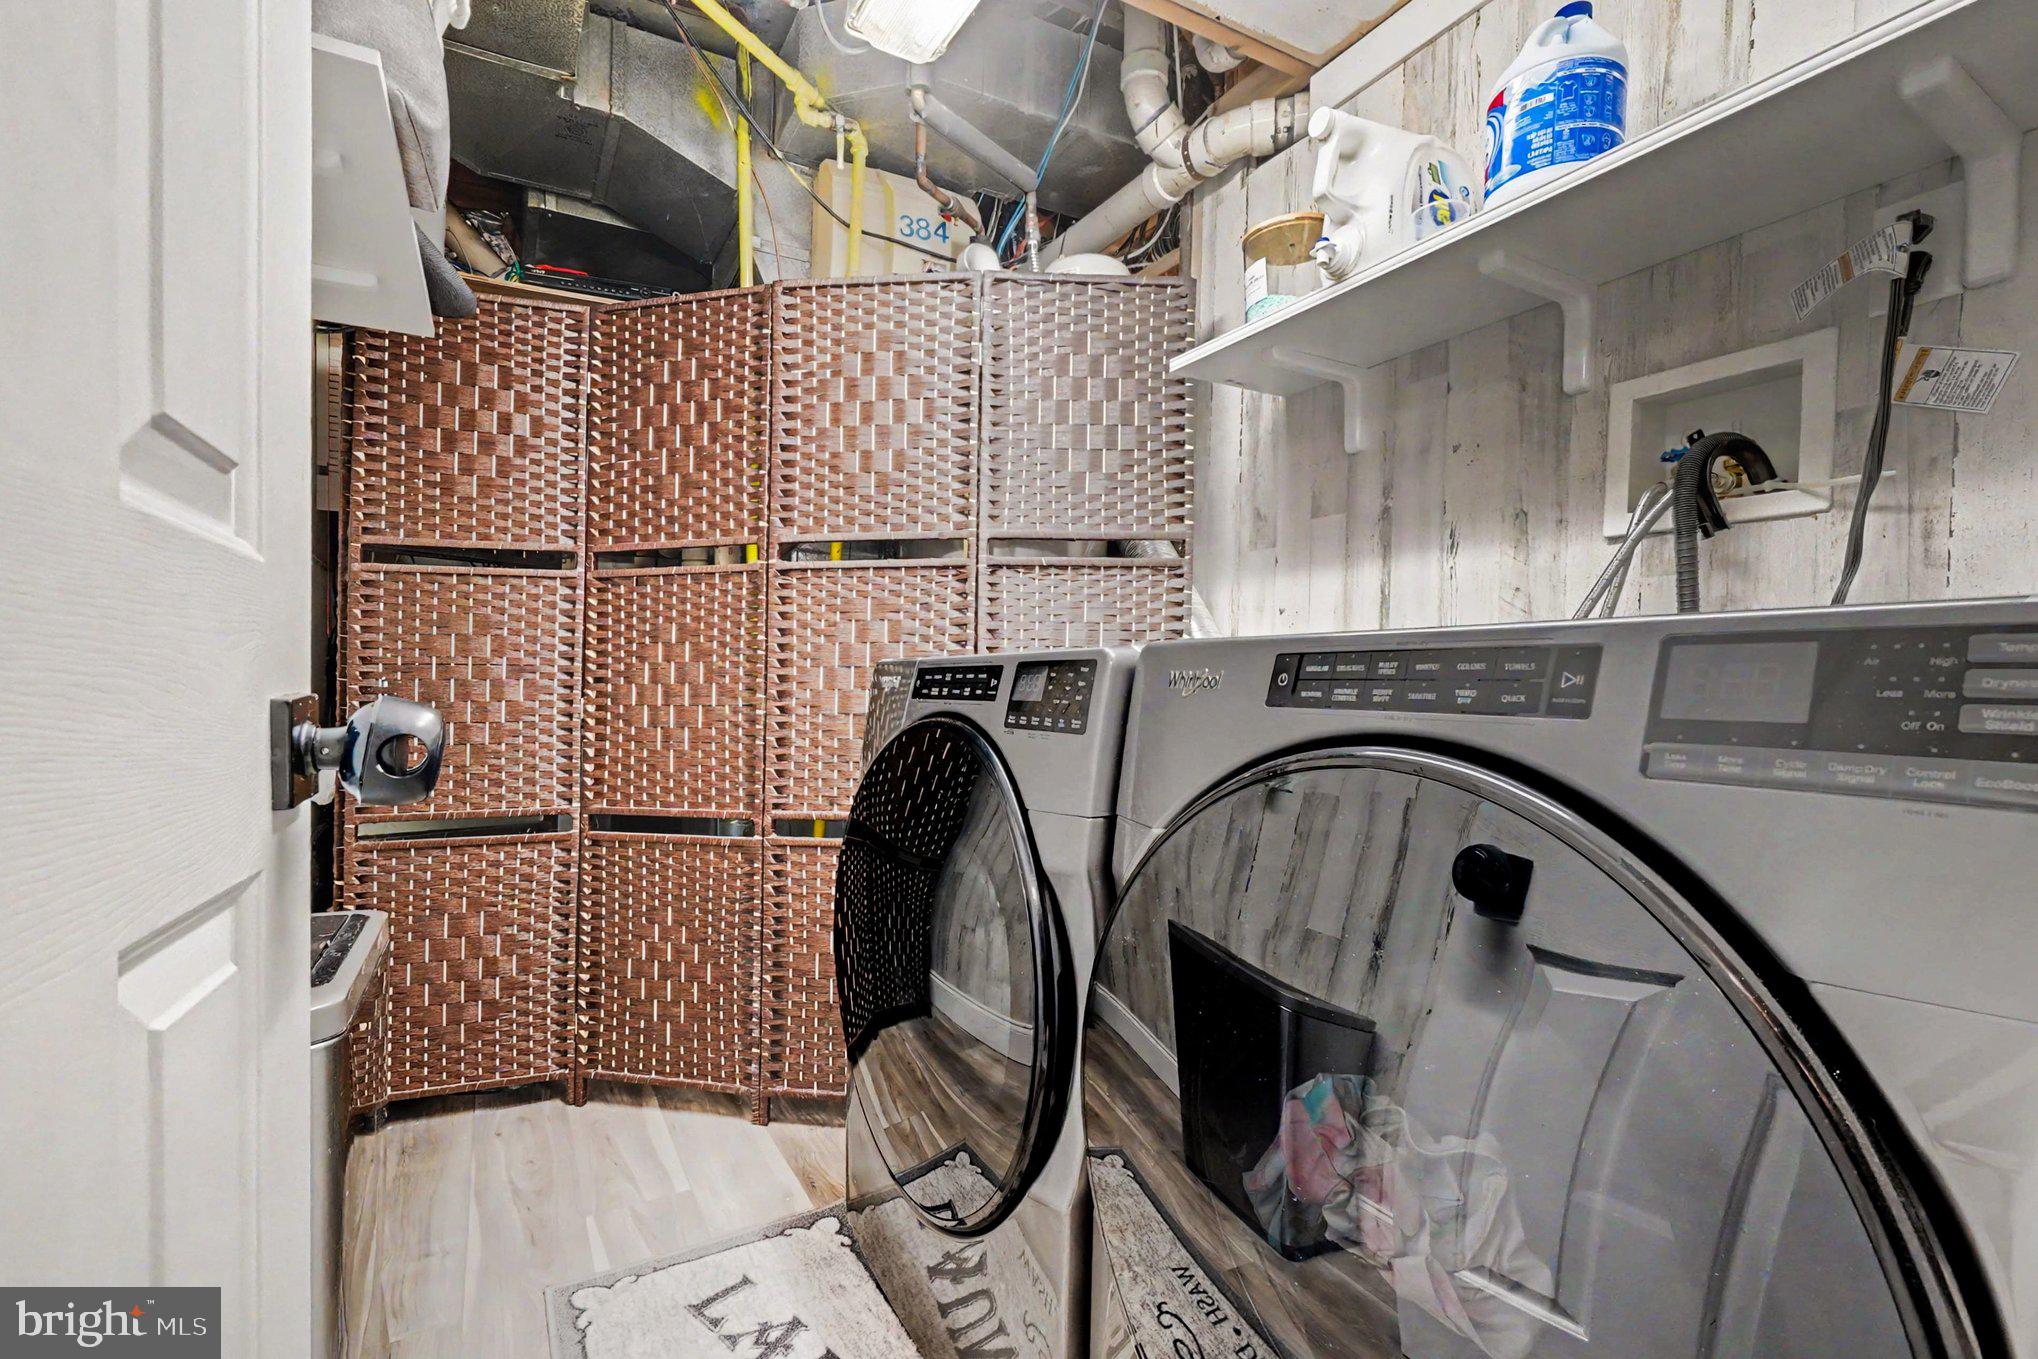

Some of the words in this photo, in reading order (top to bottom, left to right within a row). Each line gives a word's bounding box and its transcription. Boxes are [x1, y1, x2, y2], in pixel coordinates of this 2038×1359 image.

[900, 214, 950, 244] 384
[1929, 657, 1958, 667] High
[1167, 669, 1225, 698] Whirlpool
[1501, 694, 1526, 703] QUICK
[1901, 721, 1921, 731] Off
[1926, 722, 1945, 731] On
[1905, 767, 1957, 780] Control
